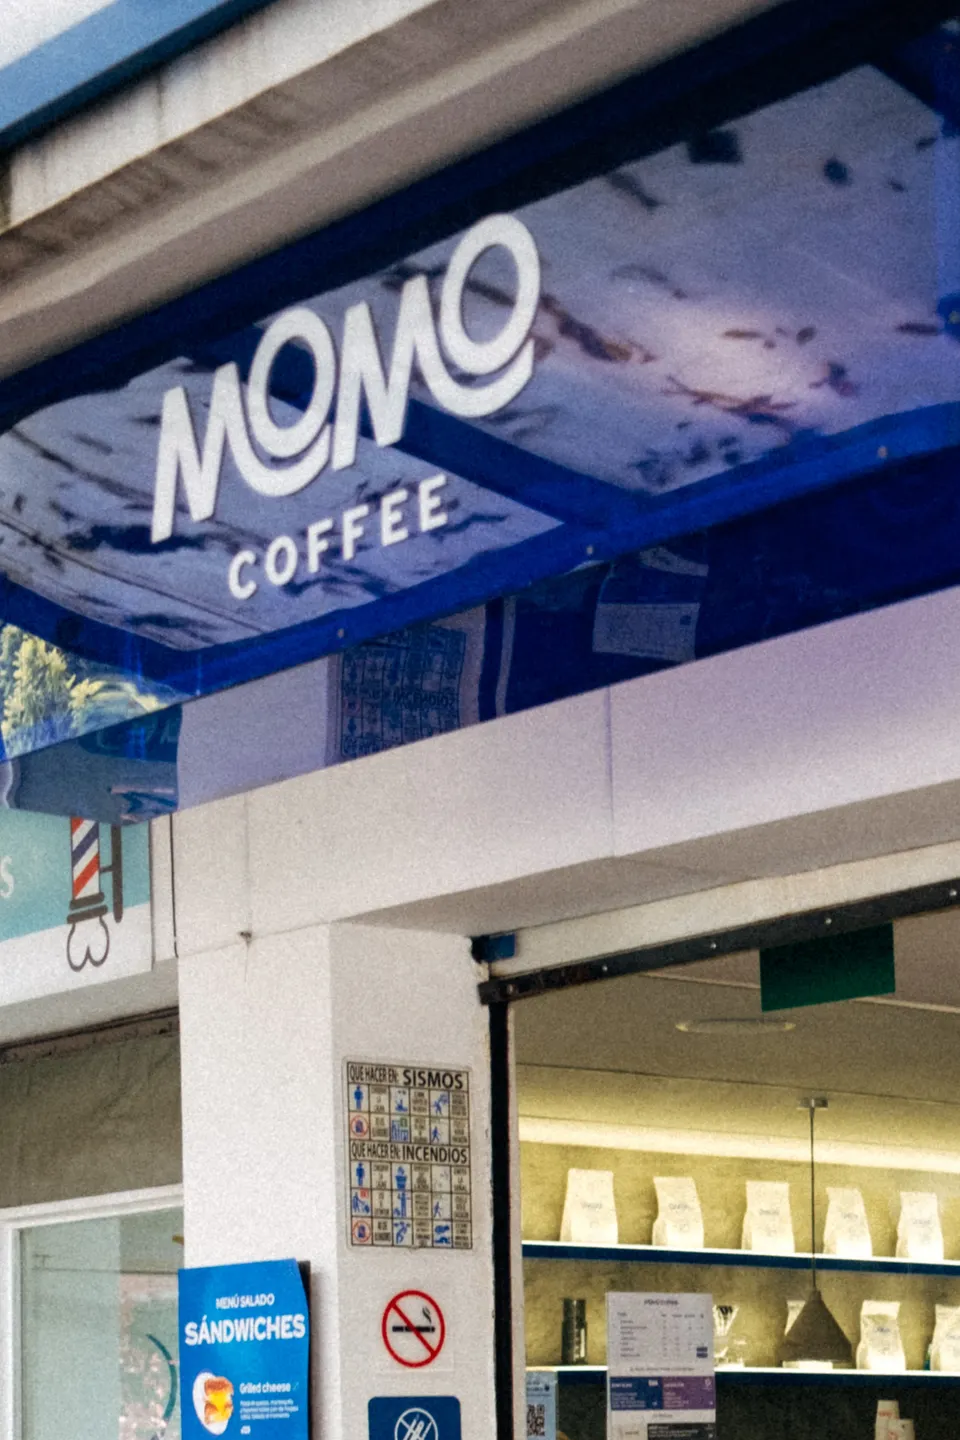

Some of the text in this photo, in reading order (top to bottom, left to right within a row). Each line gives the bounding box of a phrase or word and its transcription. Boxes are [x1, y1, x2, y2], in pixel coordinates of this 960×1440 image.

[150, 212, 541, 545] MOMO
[227, 474, 449, 600] COFFEE
[365, 1066, 387, 1083] HACER
[402, 1068, 464, 1090] SISMOS
[367, 1144, 389, 1161] HACER
[402, 1144, 468, 1164] INCENDIOS
[215, 1293, 275, 1310] MENÚ SALADO
[184, 1314, 306, 1346] SÁNDWICHES
[261, 1381, 292, 1394] cheese
